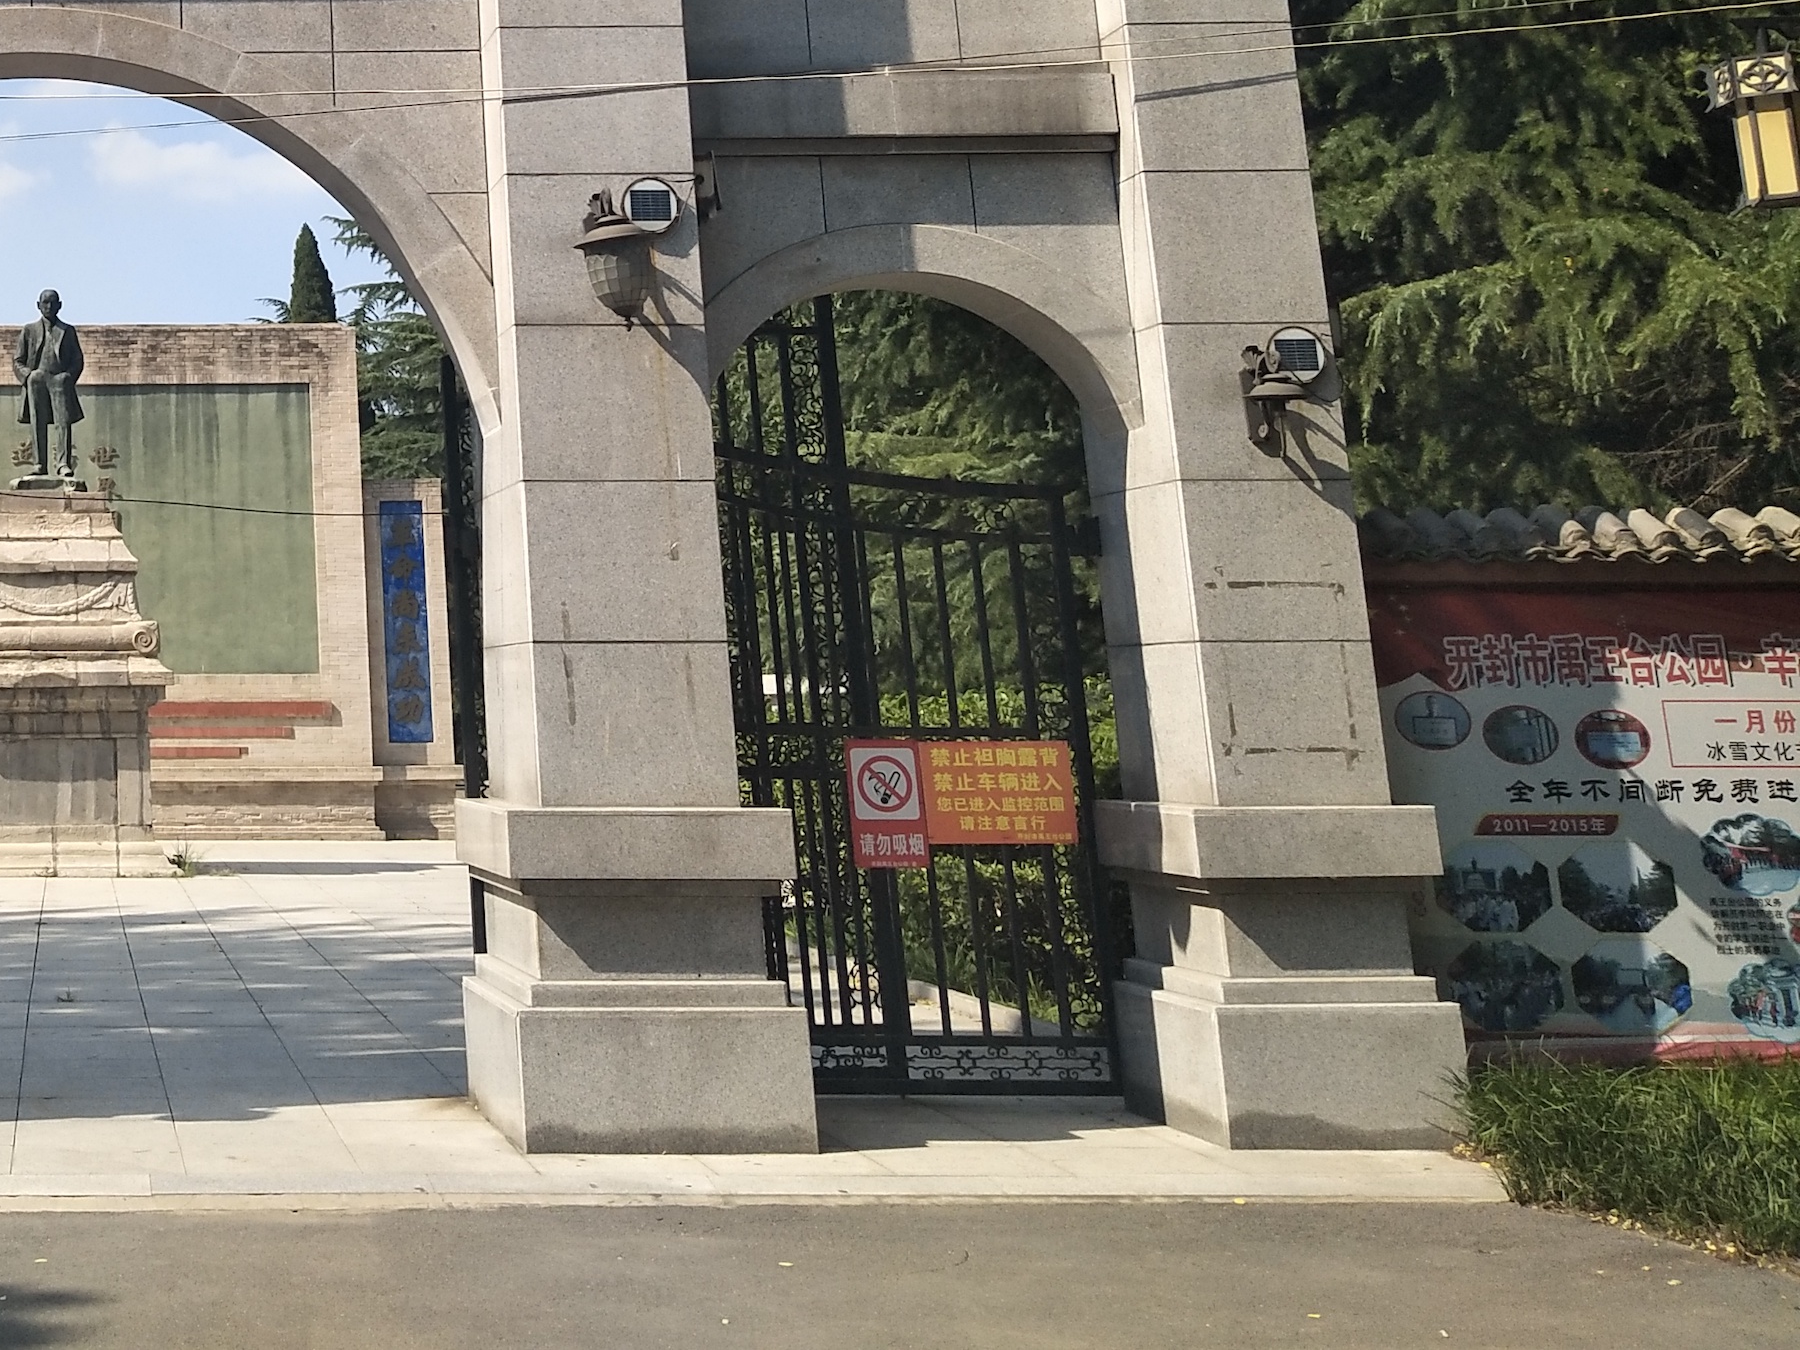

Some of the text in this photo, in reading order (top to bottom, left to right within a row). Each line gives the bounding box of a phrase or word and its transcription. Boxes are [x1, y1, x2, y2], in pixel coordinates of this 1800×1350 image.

[1714, 710, 1797, 735] 一月份
[930, 747, 1059, 768] 禁止袒胸露背
[933, 772, 1062, 793] 禁止车辆进入
[1505, 778, 1799, 805] 全年不间断免费进
[936, 796, 1065, 813] 您已进入监控范围
[959, 815, 1046, 832] 请注意言行
[859, 832, 925, 857] 请勿吸烟
